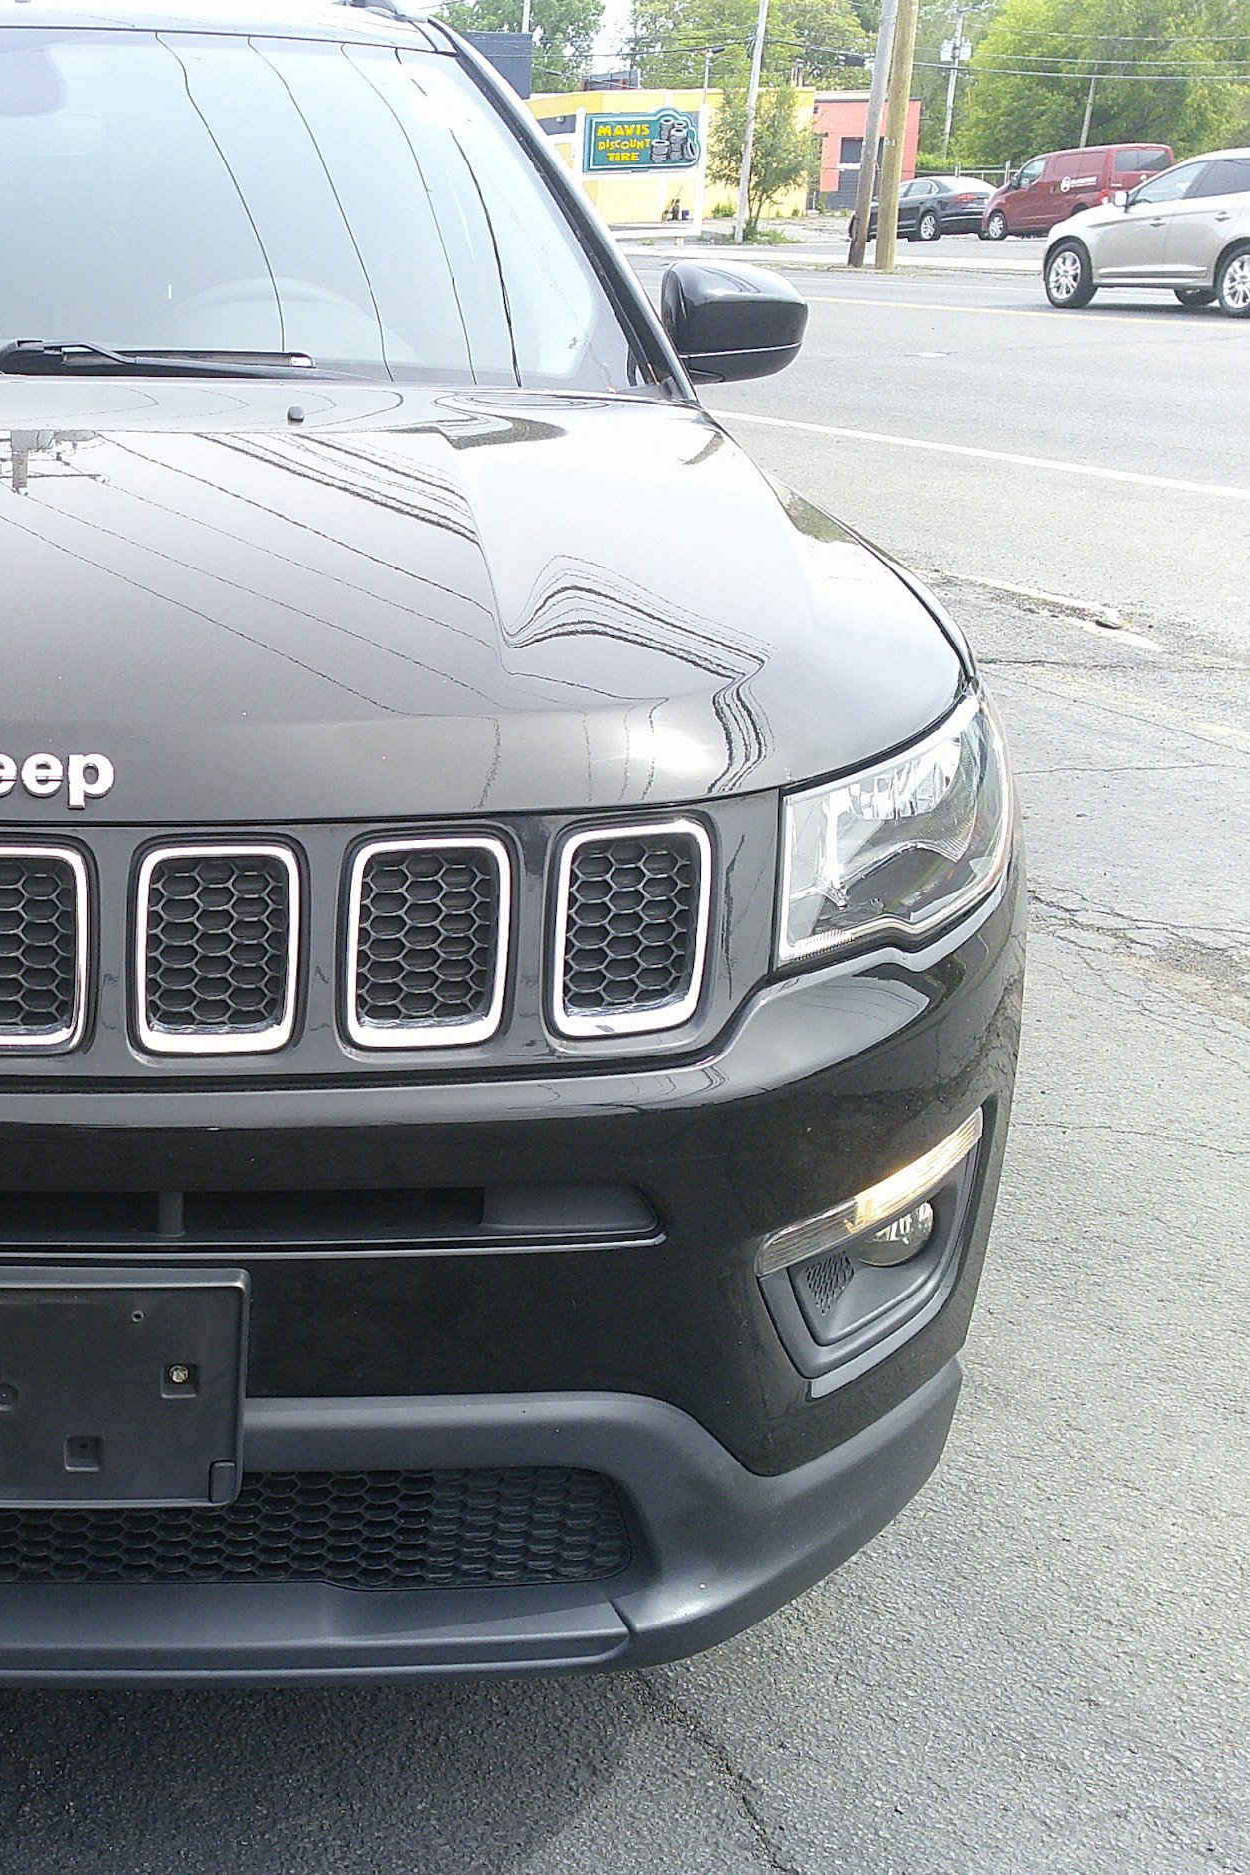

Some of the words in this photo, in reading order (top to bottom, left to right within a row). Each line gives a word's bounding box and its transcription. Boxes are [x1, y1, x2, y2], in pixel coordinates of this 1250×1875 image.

[597, 124, 650, 137] MAVIS
[597, 139, 651, 151] DISCOUNT
[607, 152, 640, 162] TIRE
